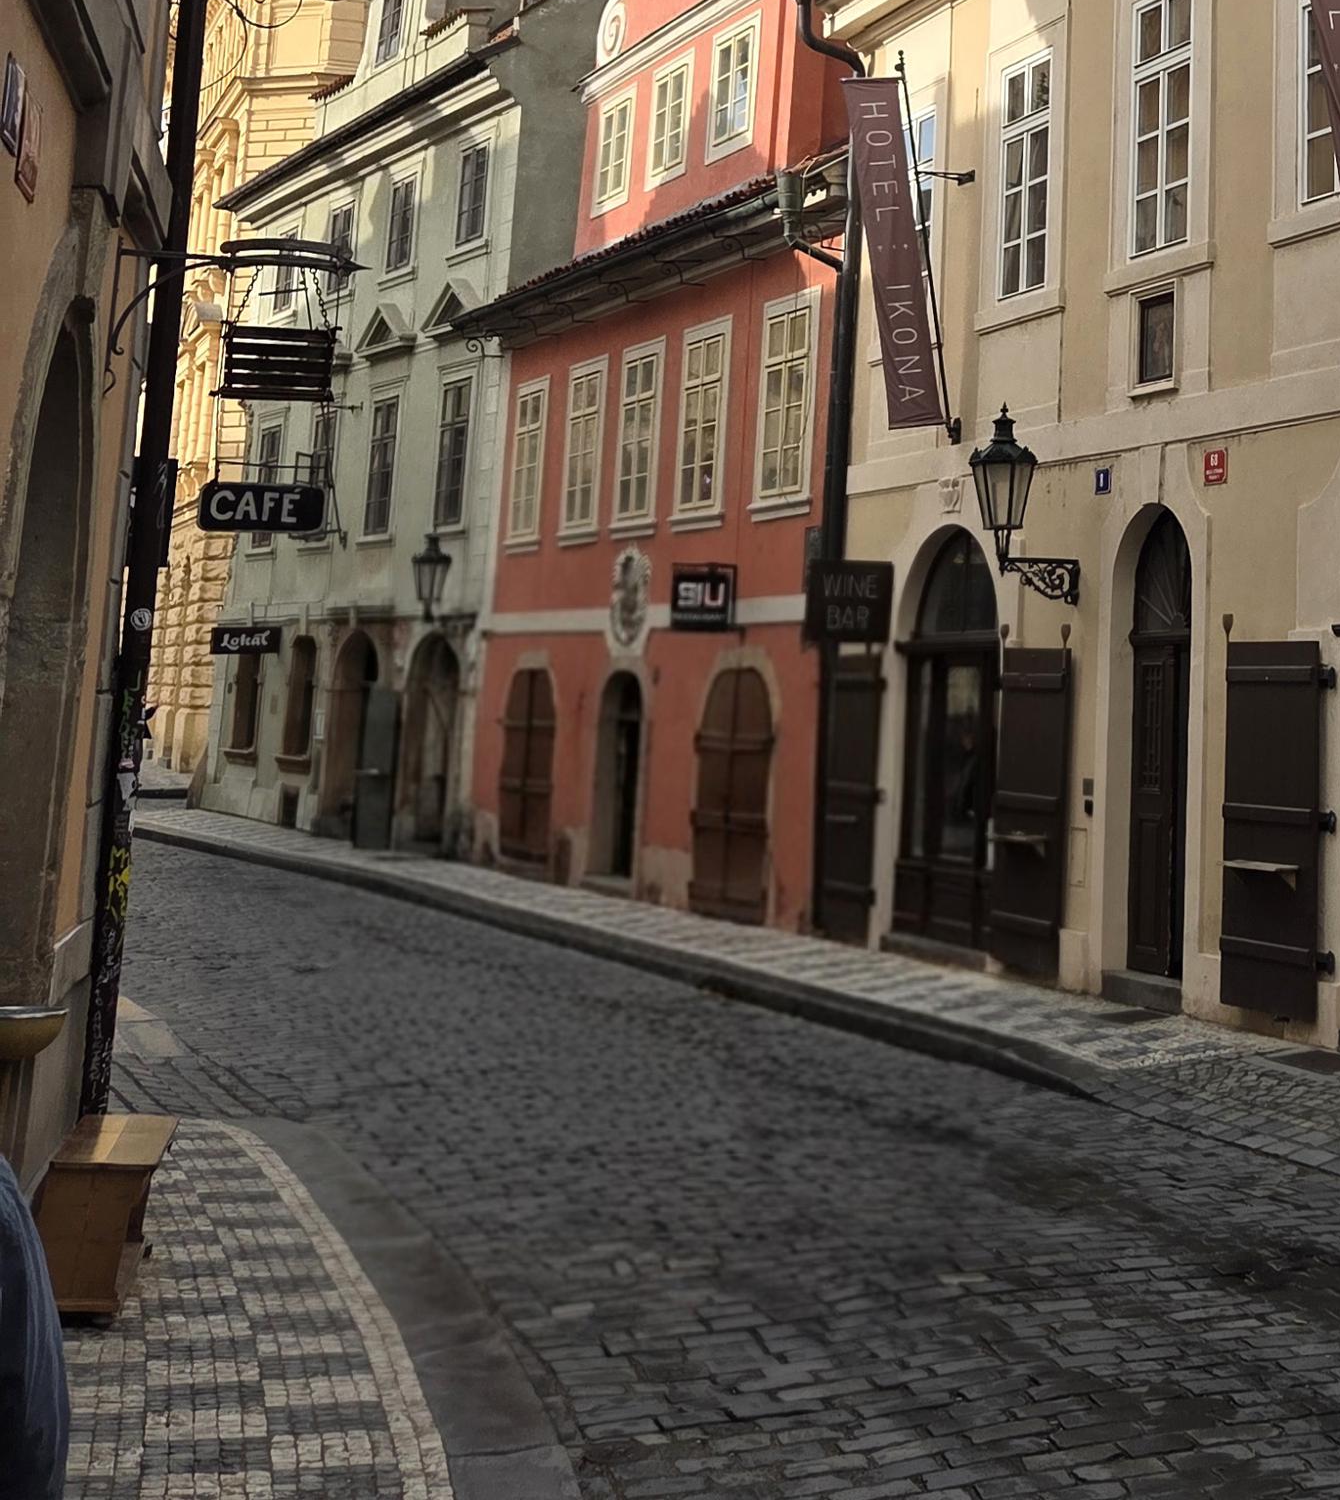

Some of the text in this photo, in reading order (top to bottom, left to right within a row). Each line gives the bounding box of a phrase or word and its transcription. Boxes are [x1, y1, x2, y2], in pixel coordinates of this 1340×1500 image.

[859, 101, 926, 402] HOTEL IKONA
[210, 487, 303, 523] CAFÉ
[823, 573, 878, 598] WINE
[826, 605, 870, 629] BAR
